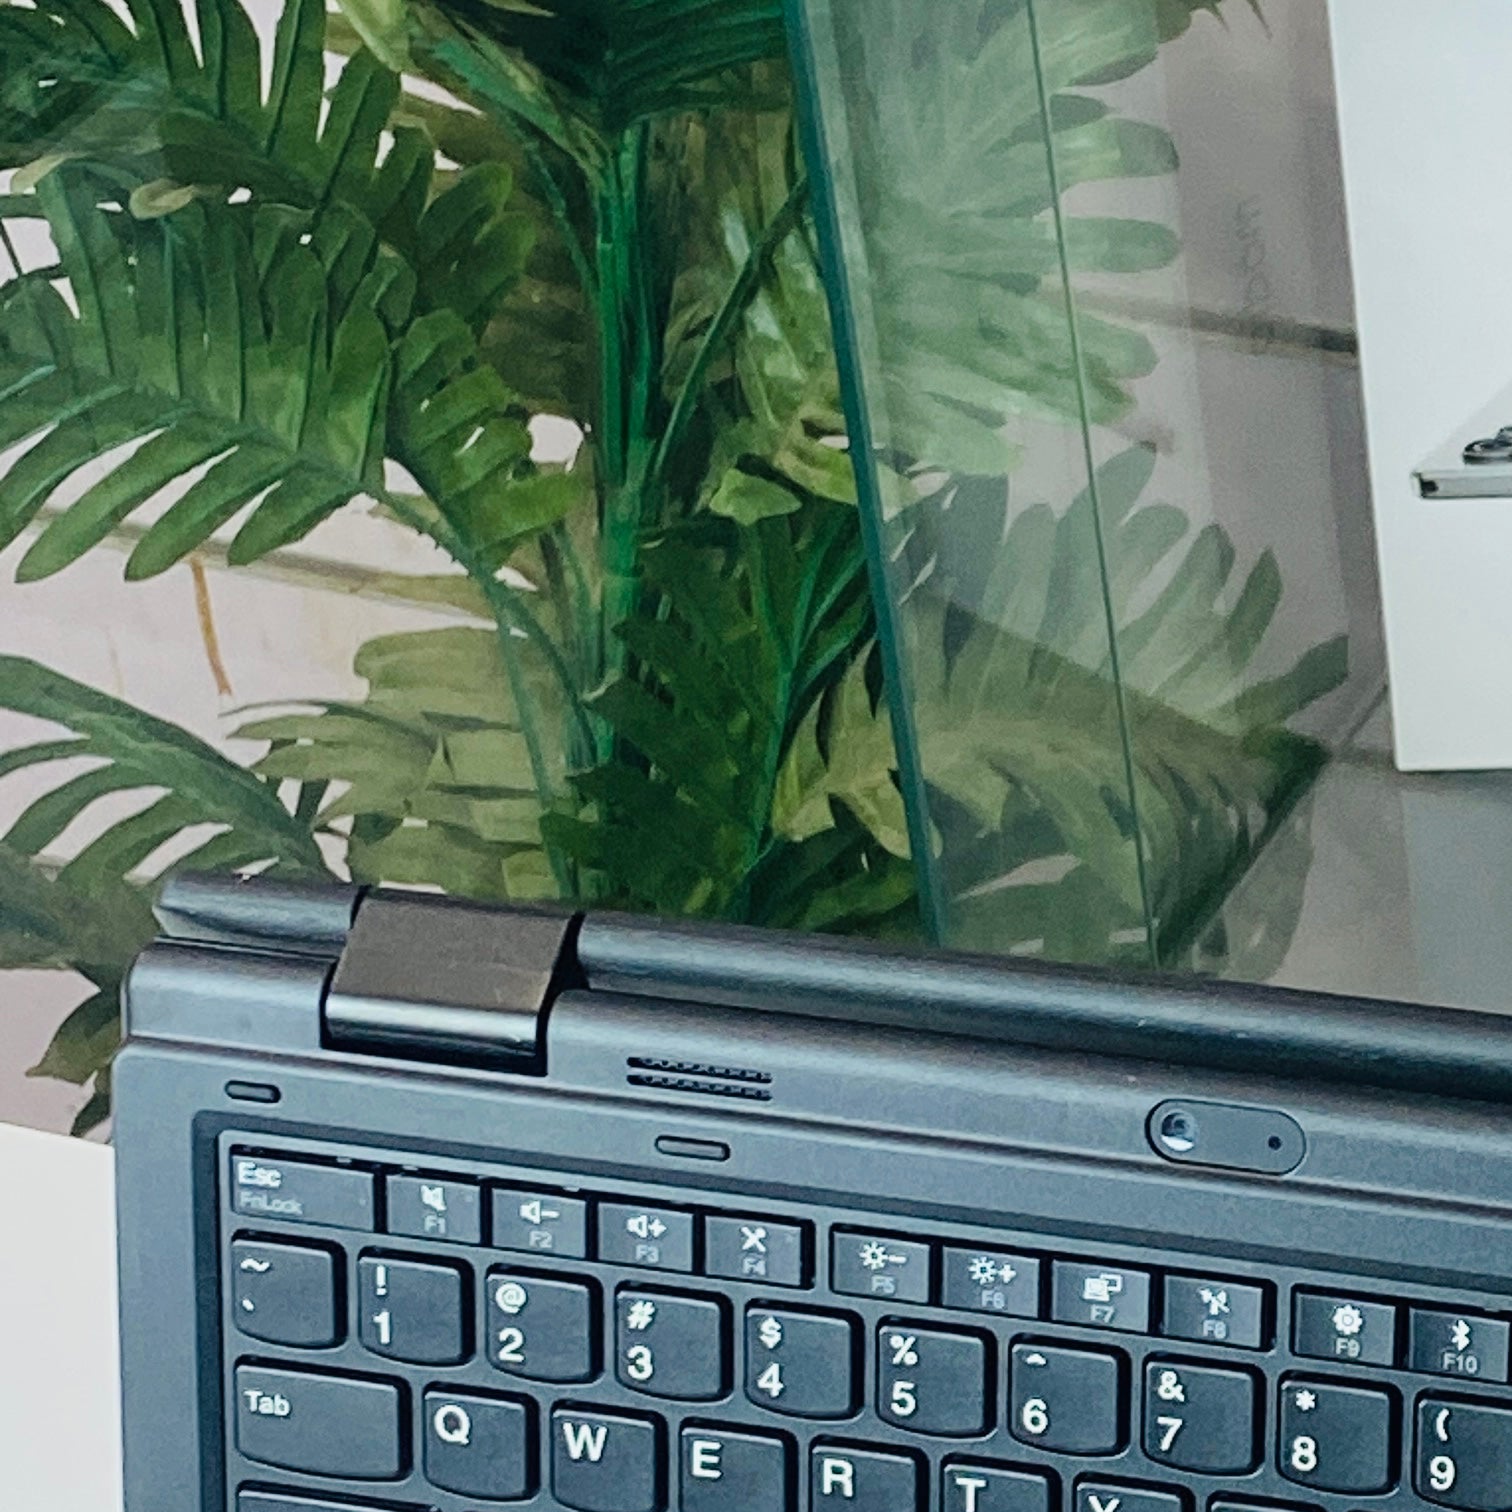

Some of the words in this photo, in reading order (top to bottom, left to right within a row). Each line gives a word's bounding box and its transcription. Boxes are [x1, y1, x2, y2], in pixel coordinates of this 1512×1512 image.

[237, 1161, 281, 1188] Esc
[424, 1214, 446, 1234] F1
[529, 1230, 553, 1249] F2
[635, 1243, 659, 1263] F3
[742, 1257, 766, 1276] F4
[375, 1265, 387, 1295] !
[495, 1282, 527, 1314] @
[1090, 1303, 1115, 1324] F7
[373, 1310, 390, 1344] 1
[627, 1300, 655, 1330] #
[498, 1327, 524, 1362] 2
[759, 1317, 782, 1350] $
[889, 1334, 918, 1366] %
[1335, 1337, 1360, 1358] F9
[627, 1345, 653, 1380] 3
[1442, 1352, 1478, 1374] F10
[757, 1362, 784, 1397] 4
[1157, 1370, 1185, 1402] &
[243, 1389, 290, 1416] Tab
[890, 1380, 916, 1416] 5
[434, 1404, 470, 1445] Q
[1022, 1398, 1048, 1434] 6
[1435, 1408, 1450, 1441] (
[562, 1422, 608, 1461] W
[1157, 1416, 1183, 1451] 7
[692, 1440, 722, 1479] E
[1291, 1435, 1317, 1472] 8
[822, 1457, 853, 1497] R
[1429, 1455, 1455, 1491] 9
